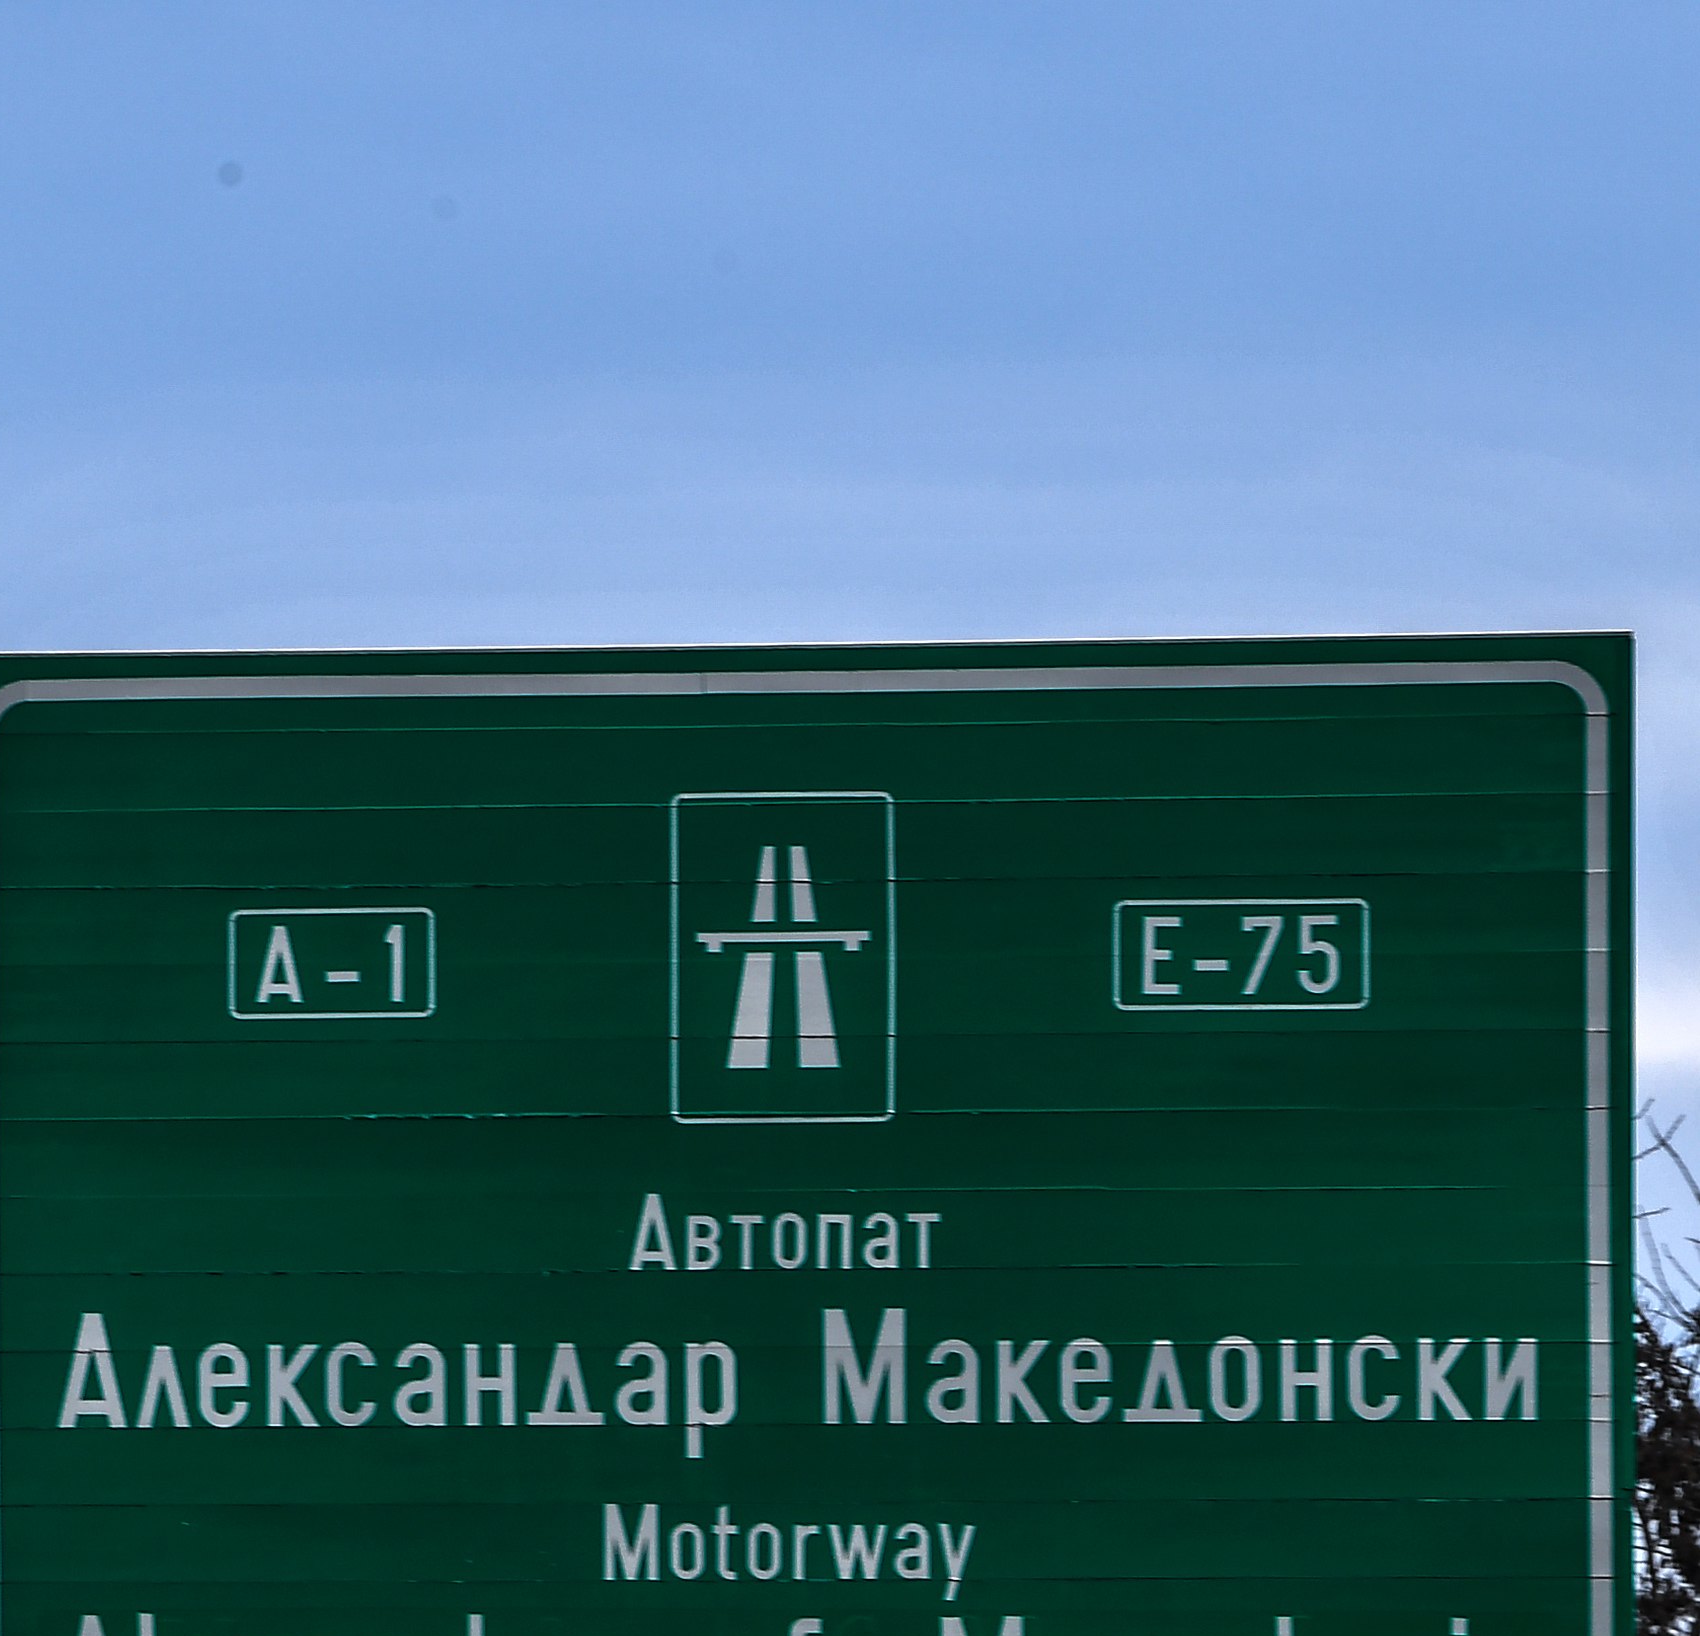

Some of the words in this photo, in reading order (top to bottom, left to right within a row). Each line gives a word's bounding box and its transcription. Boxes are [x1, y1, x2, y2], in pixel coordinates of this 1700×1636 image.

[257, 924, 404, 1004] A-1
[1142, 914, 1339, 996] E-75
[629, 1193, 942, 1271] Автопат
[58, 1312, 738, 1459] Александар
[822, 1308, 1539, 1424] Македонски
[604, 1502, 976, 1600] Motorway
